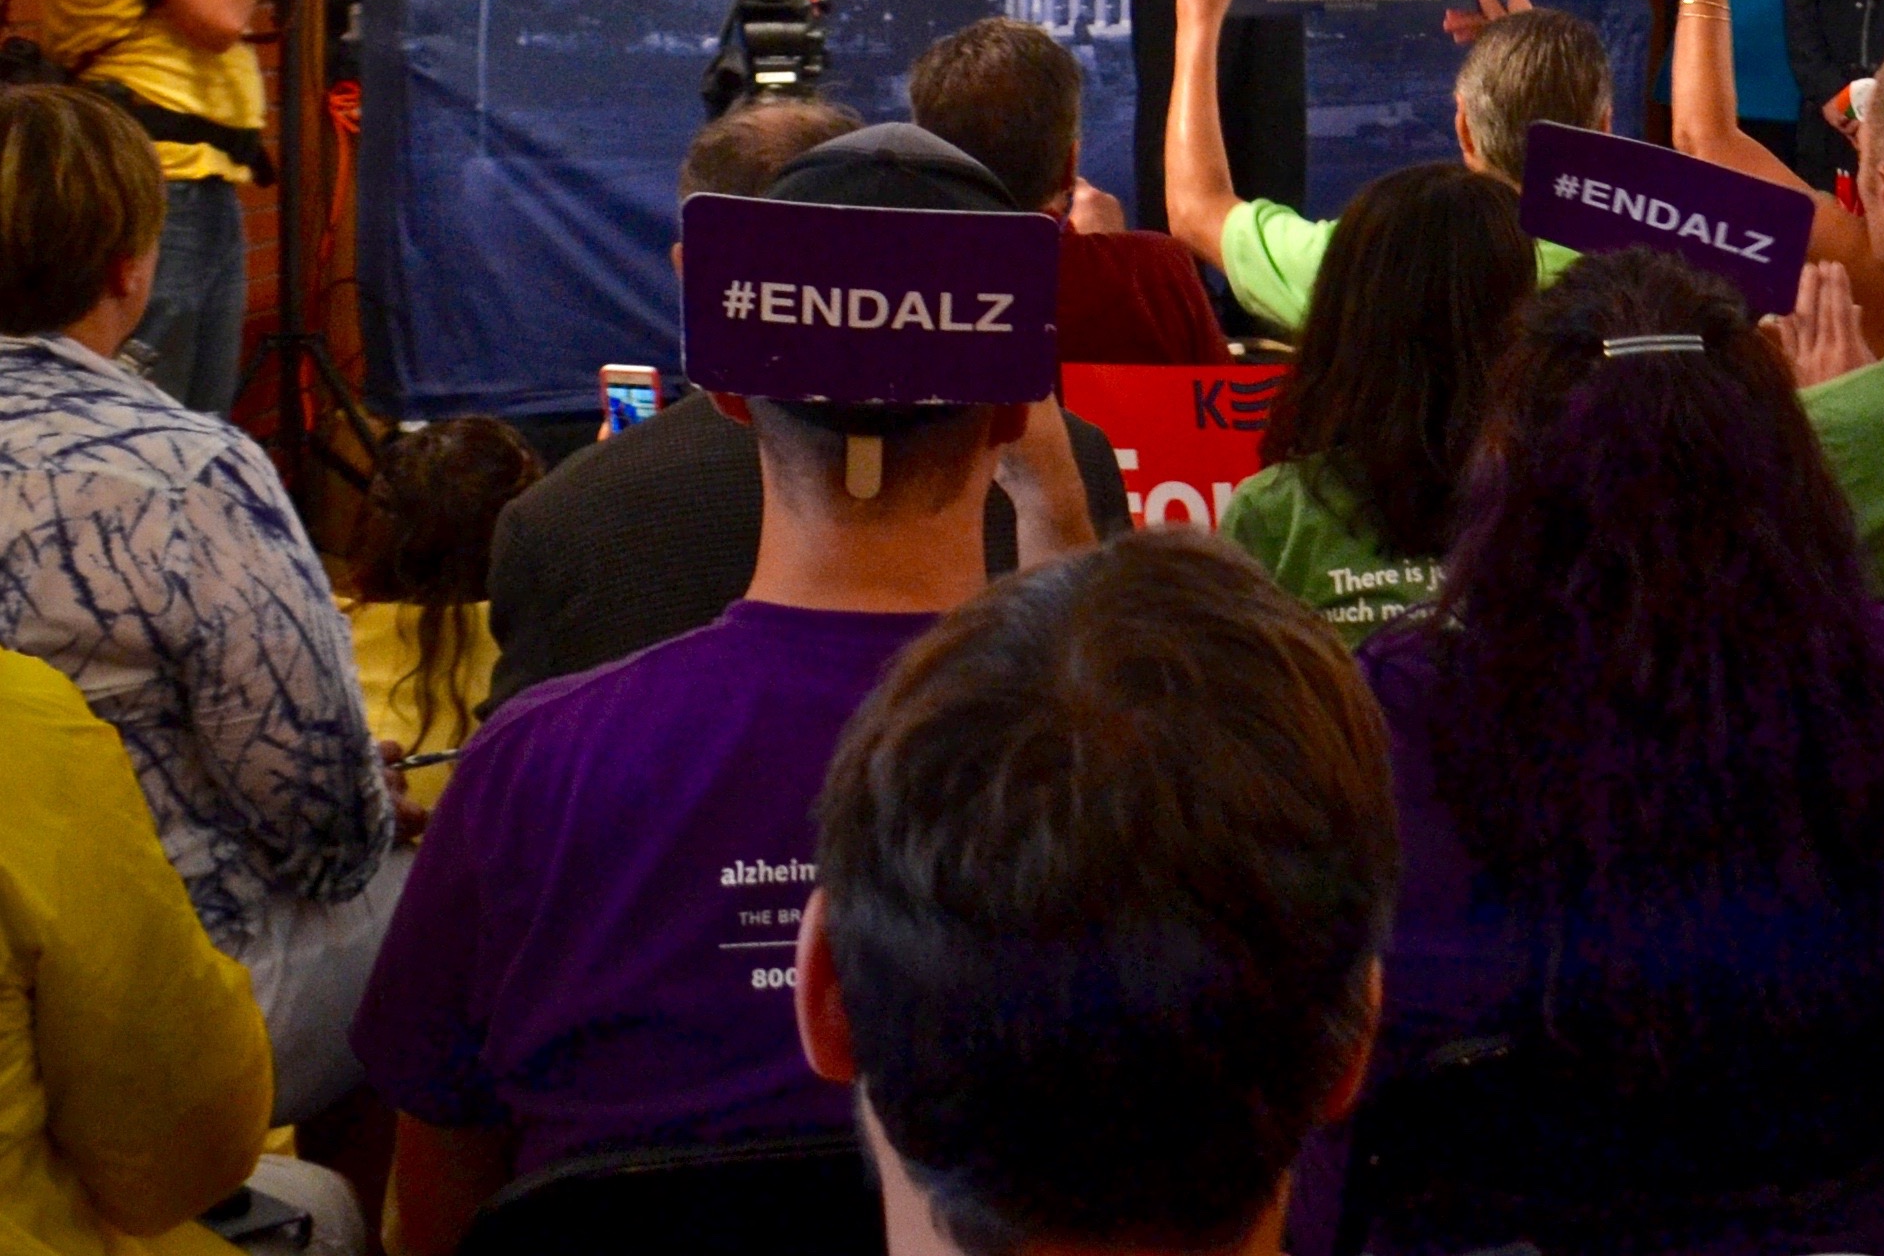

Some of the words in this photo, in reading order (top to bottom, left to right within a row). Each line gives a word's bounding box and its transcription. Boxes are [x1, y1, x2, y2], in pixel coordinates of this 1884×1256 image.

[1552, 172, 1776, 264] #ENDALZ
[722, 278, 1015, 334] #ENDALZ
[1328, 567, 1399, 595] There
[1403, 558, 1424, 583] is
[737, 909, 773, 927] THE
